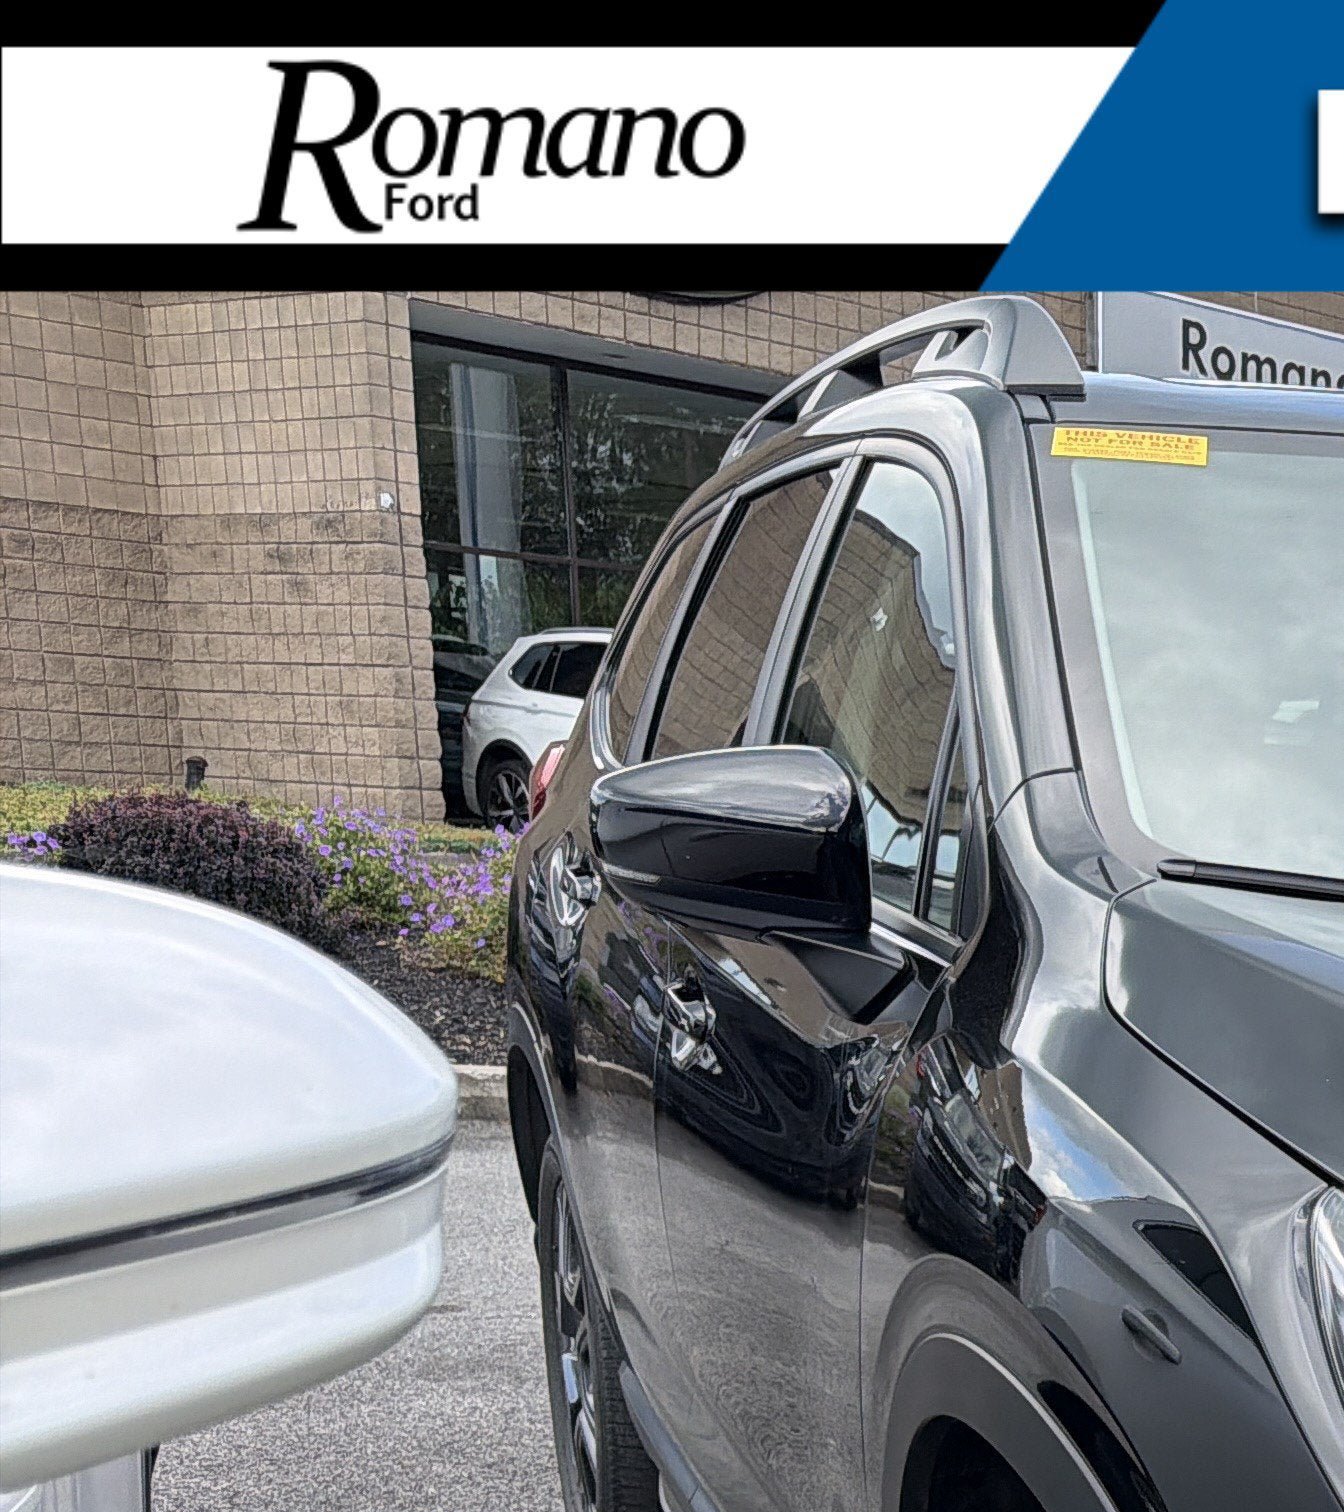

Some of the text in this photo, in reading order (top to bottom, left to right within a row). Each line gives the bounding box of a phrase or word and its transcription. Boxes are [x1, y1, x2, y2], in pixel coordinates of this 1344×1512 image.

[1066, 436, 1101, 444] NOT
[1108, 438, 1144, 447] FOR
[1150, 441, 1196, 450] SALE
[1115, 432, 1201, 445] VEHICLE
